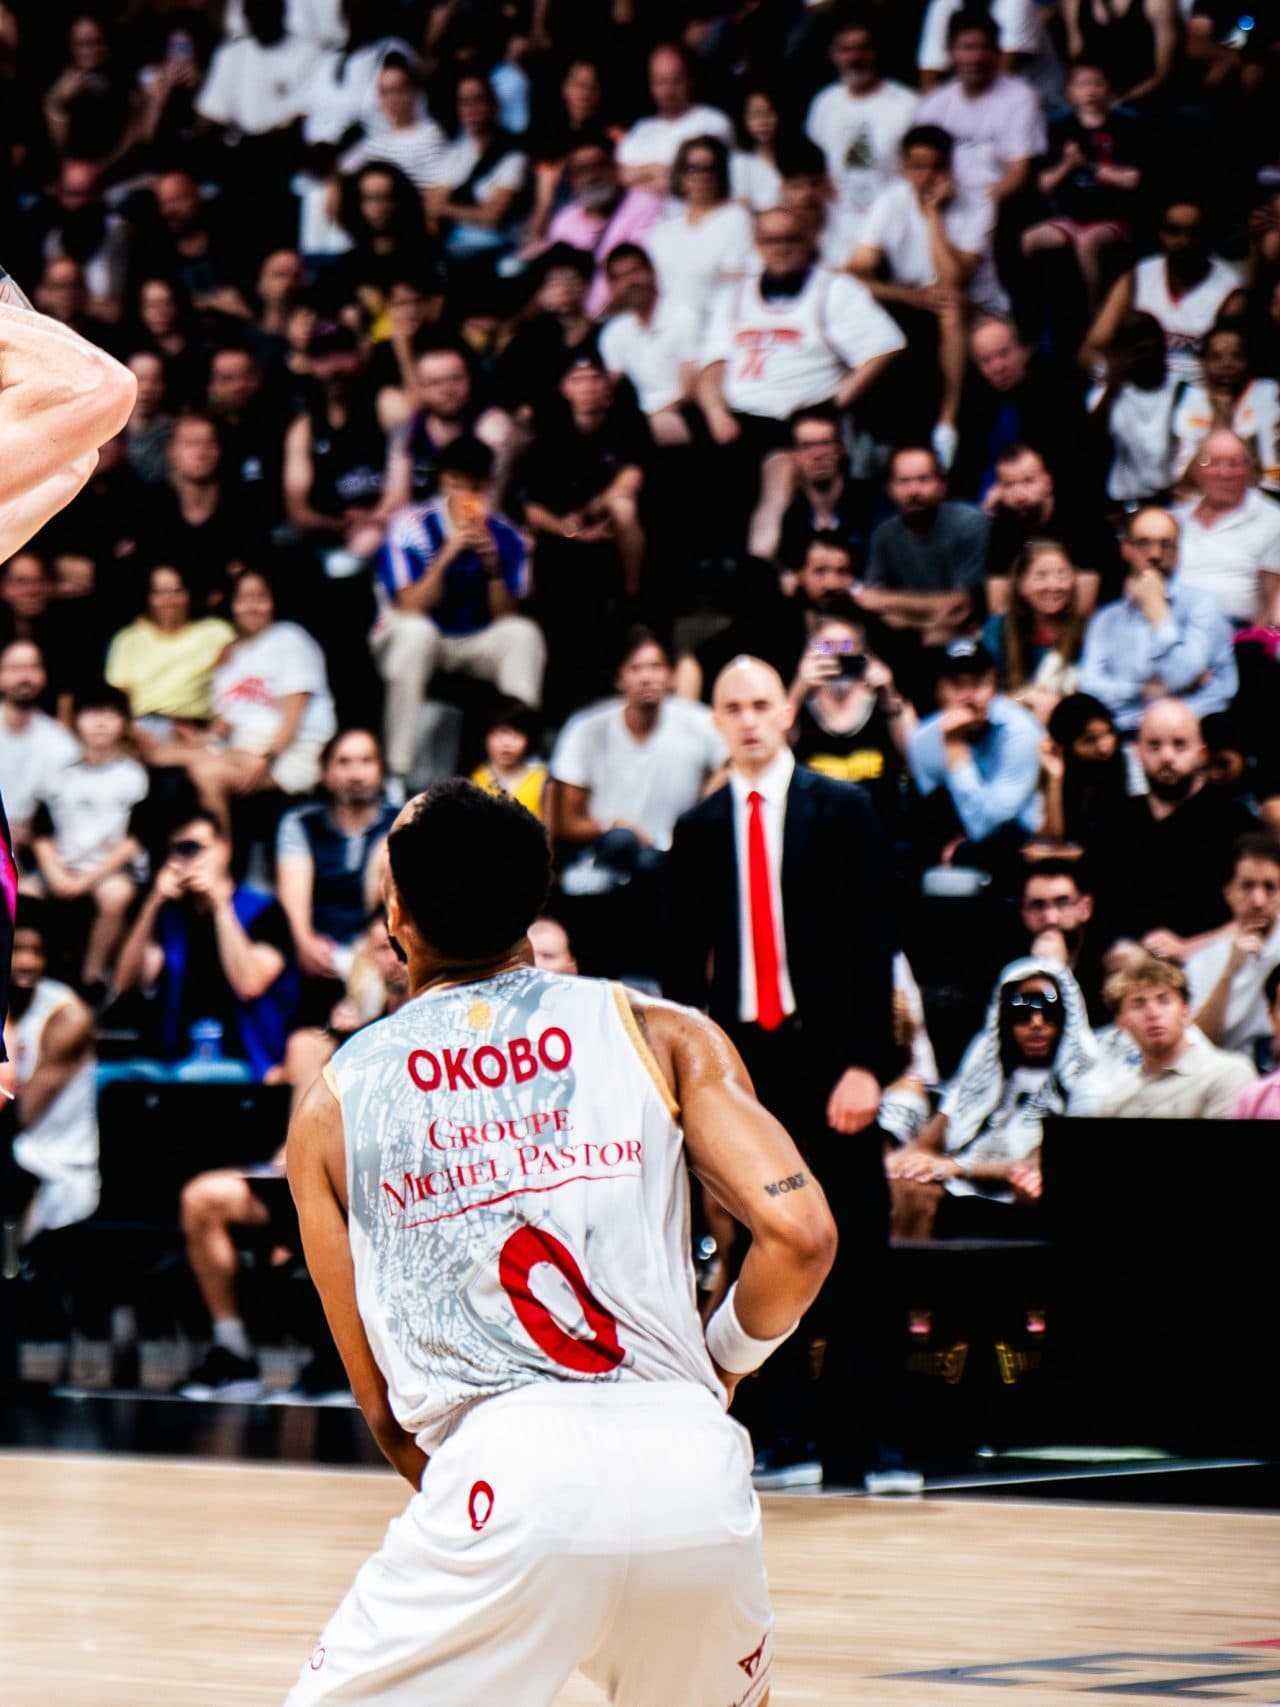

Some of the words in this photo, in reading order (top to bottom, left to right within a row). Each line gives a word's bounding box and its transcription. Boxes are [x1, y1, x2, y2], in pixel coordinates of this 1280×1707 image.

[407, 1027, 572, 1092] OKOBO
[428, 1109, 574, 1151] GROUPE
[381, 1158, 510, 1216] MICHEL
[516, 1139, 642, 1177] PASTOR
[498, 1224, 625, 1374] 0
[467, 1480, 495, 1532] 0
